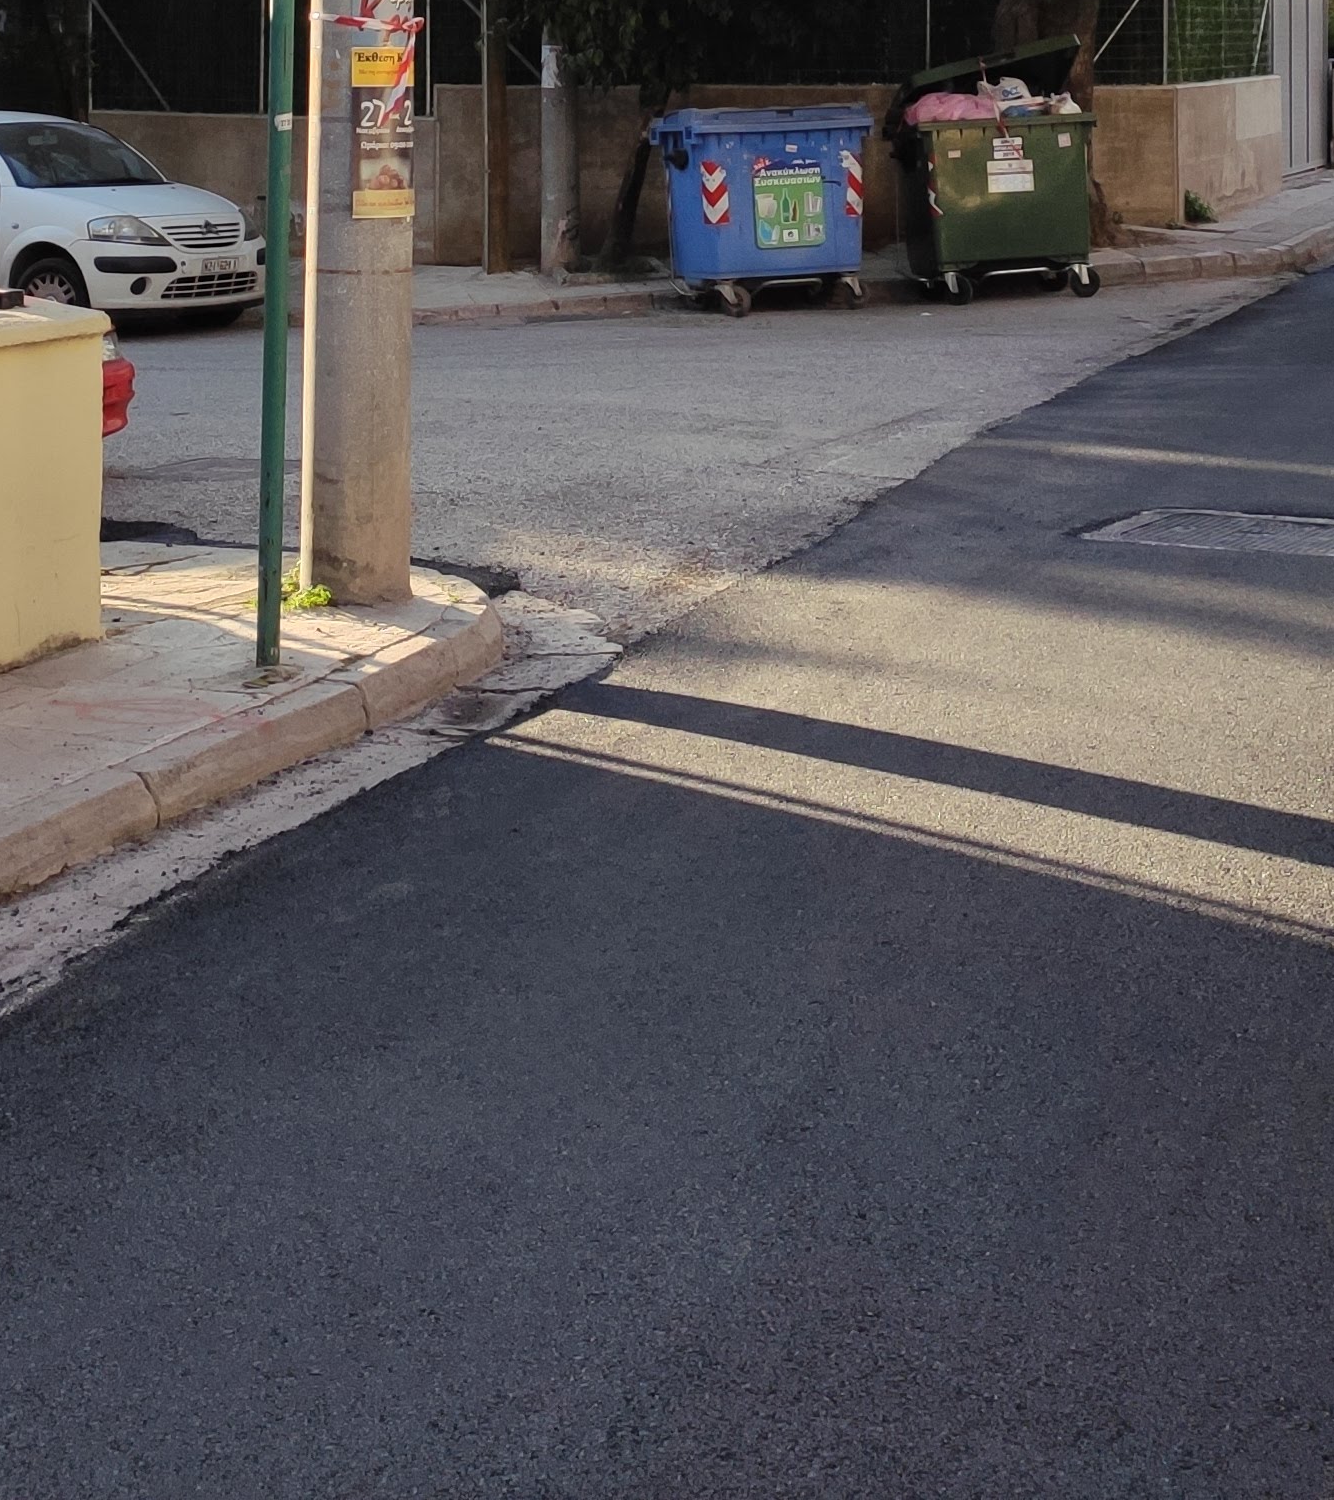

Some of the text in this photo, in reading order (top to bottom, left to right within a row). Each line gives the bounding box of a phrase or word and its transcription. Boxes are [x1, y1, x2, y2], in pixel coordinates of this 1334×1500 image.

[354, 51, 395, 65] Έκθεση
[360, 98, 385, 127] 27
[759, 167, 820, 177] Ανακύκλωση
[753, 176, 821, 187] Συσκευασιών
